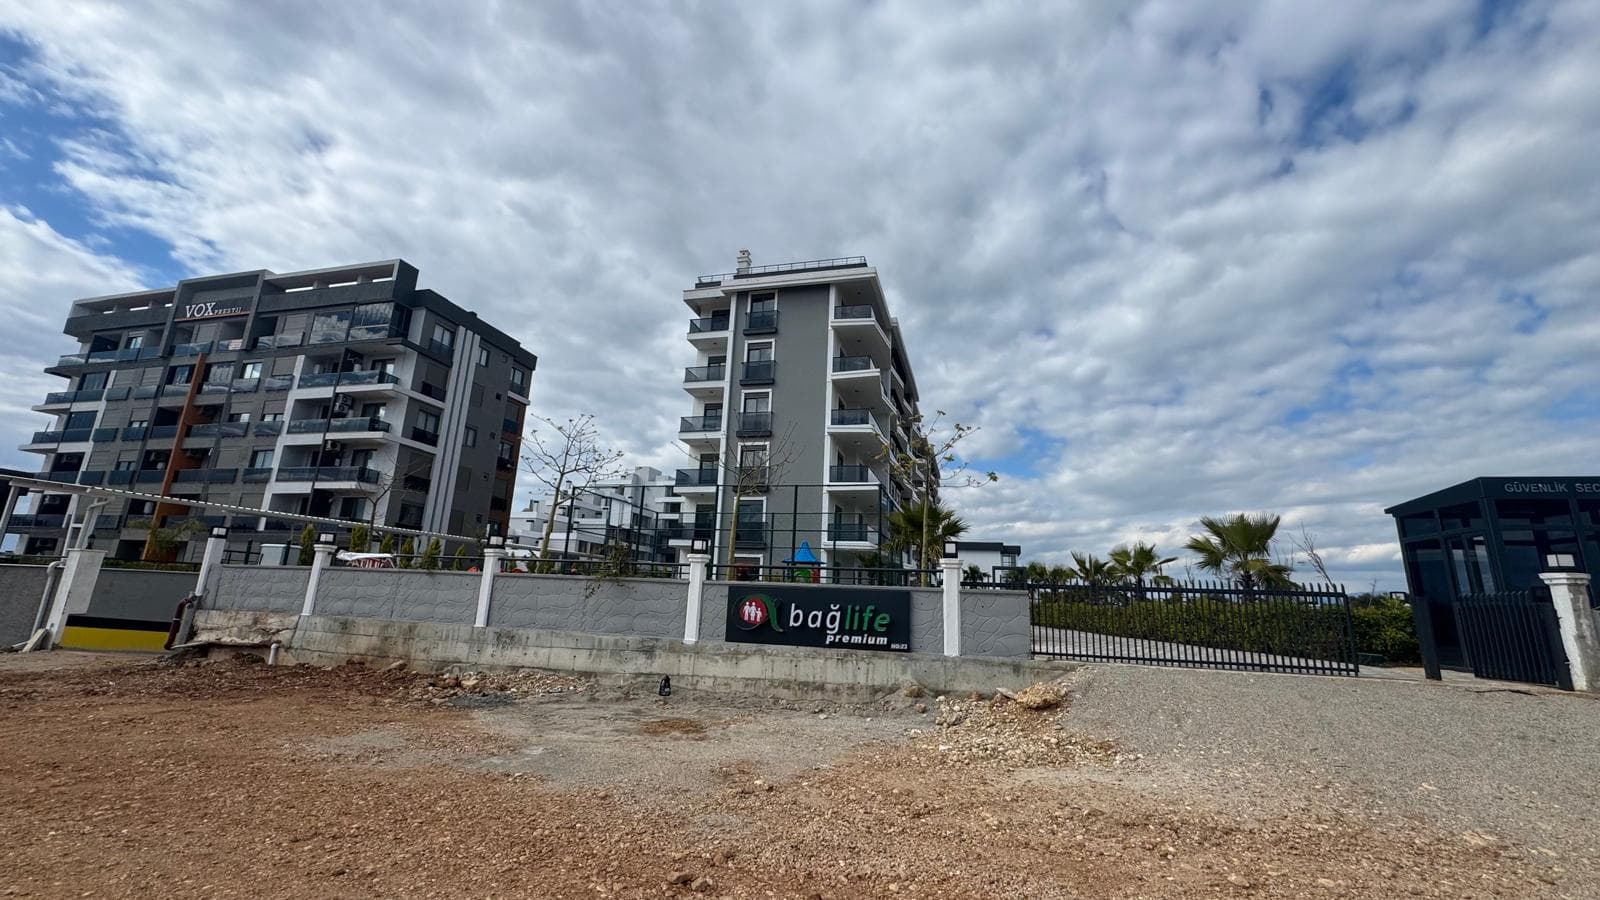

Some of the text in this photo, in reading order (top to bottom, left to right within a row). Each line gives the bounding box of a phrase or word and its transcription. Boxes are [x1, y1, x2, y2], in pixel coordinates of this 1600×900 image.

[185, 302, 216, 318] VOX
[1504, 481, 1568, 493] GÜVENLİK
[825, 634, 888, 645] premium
